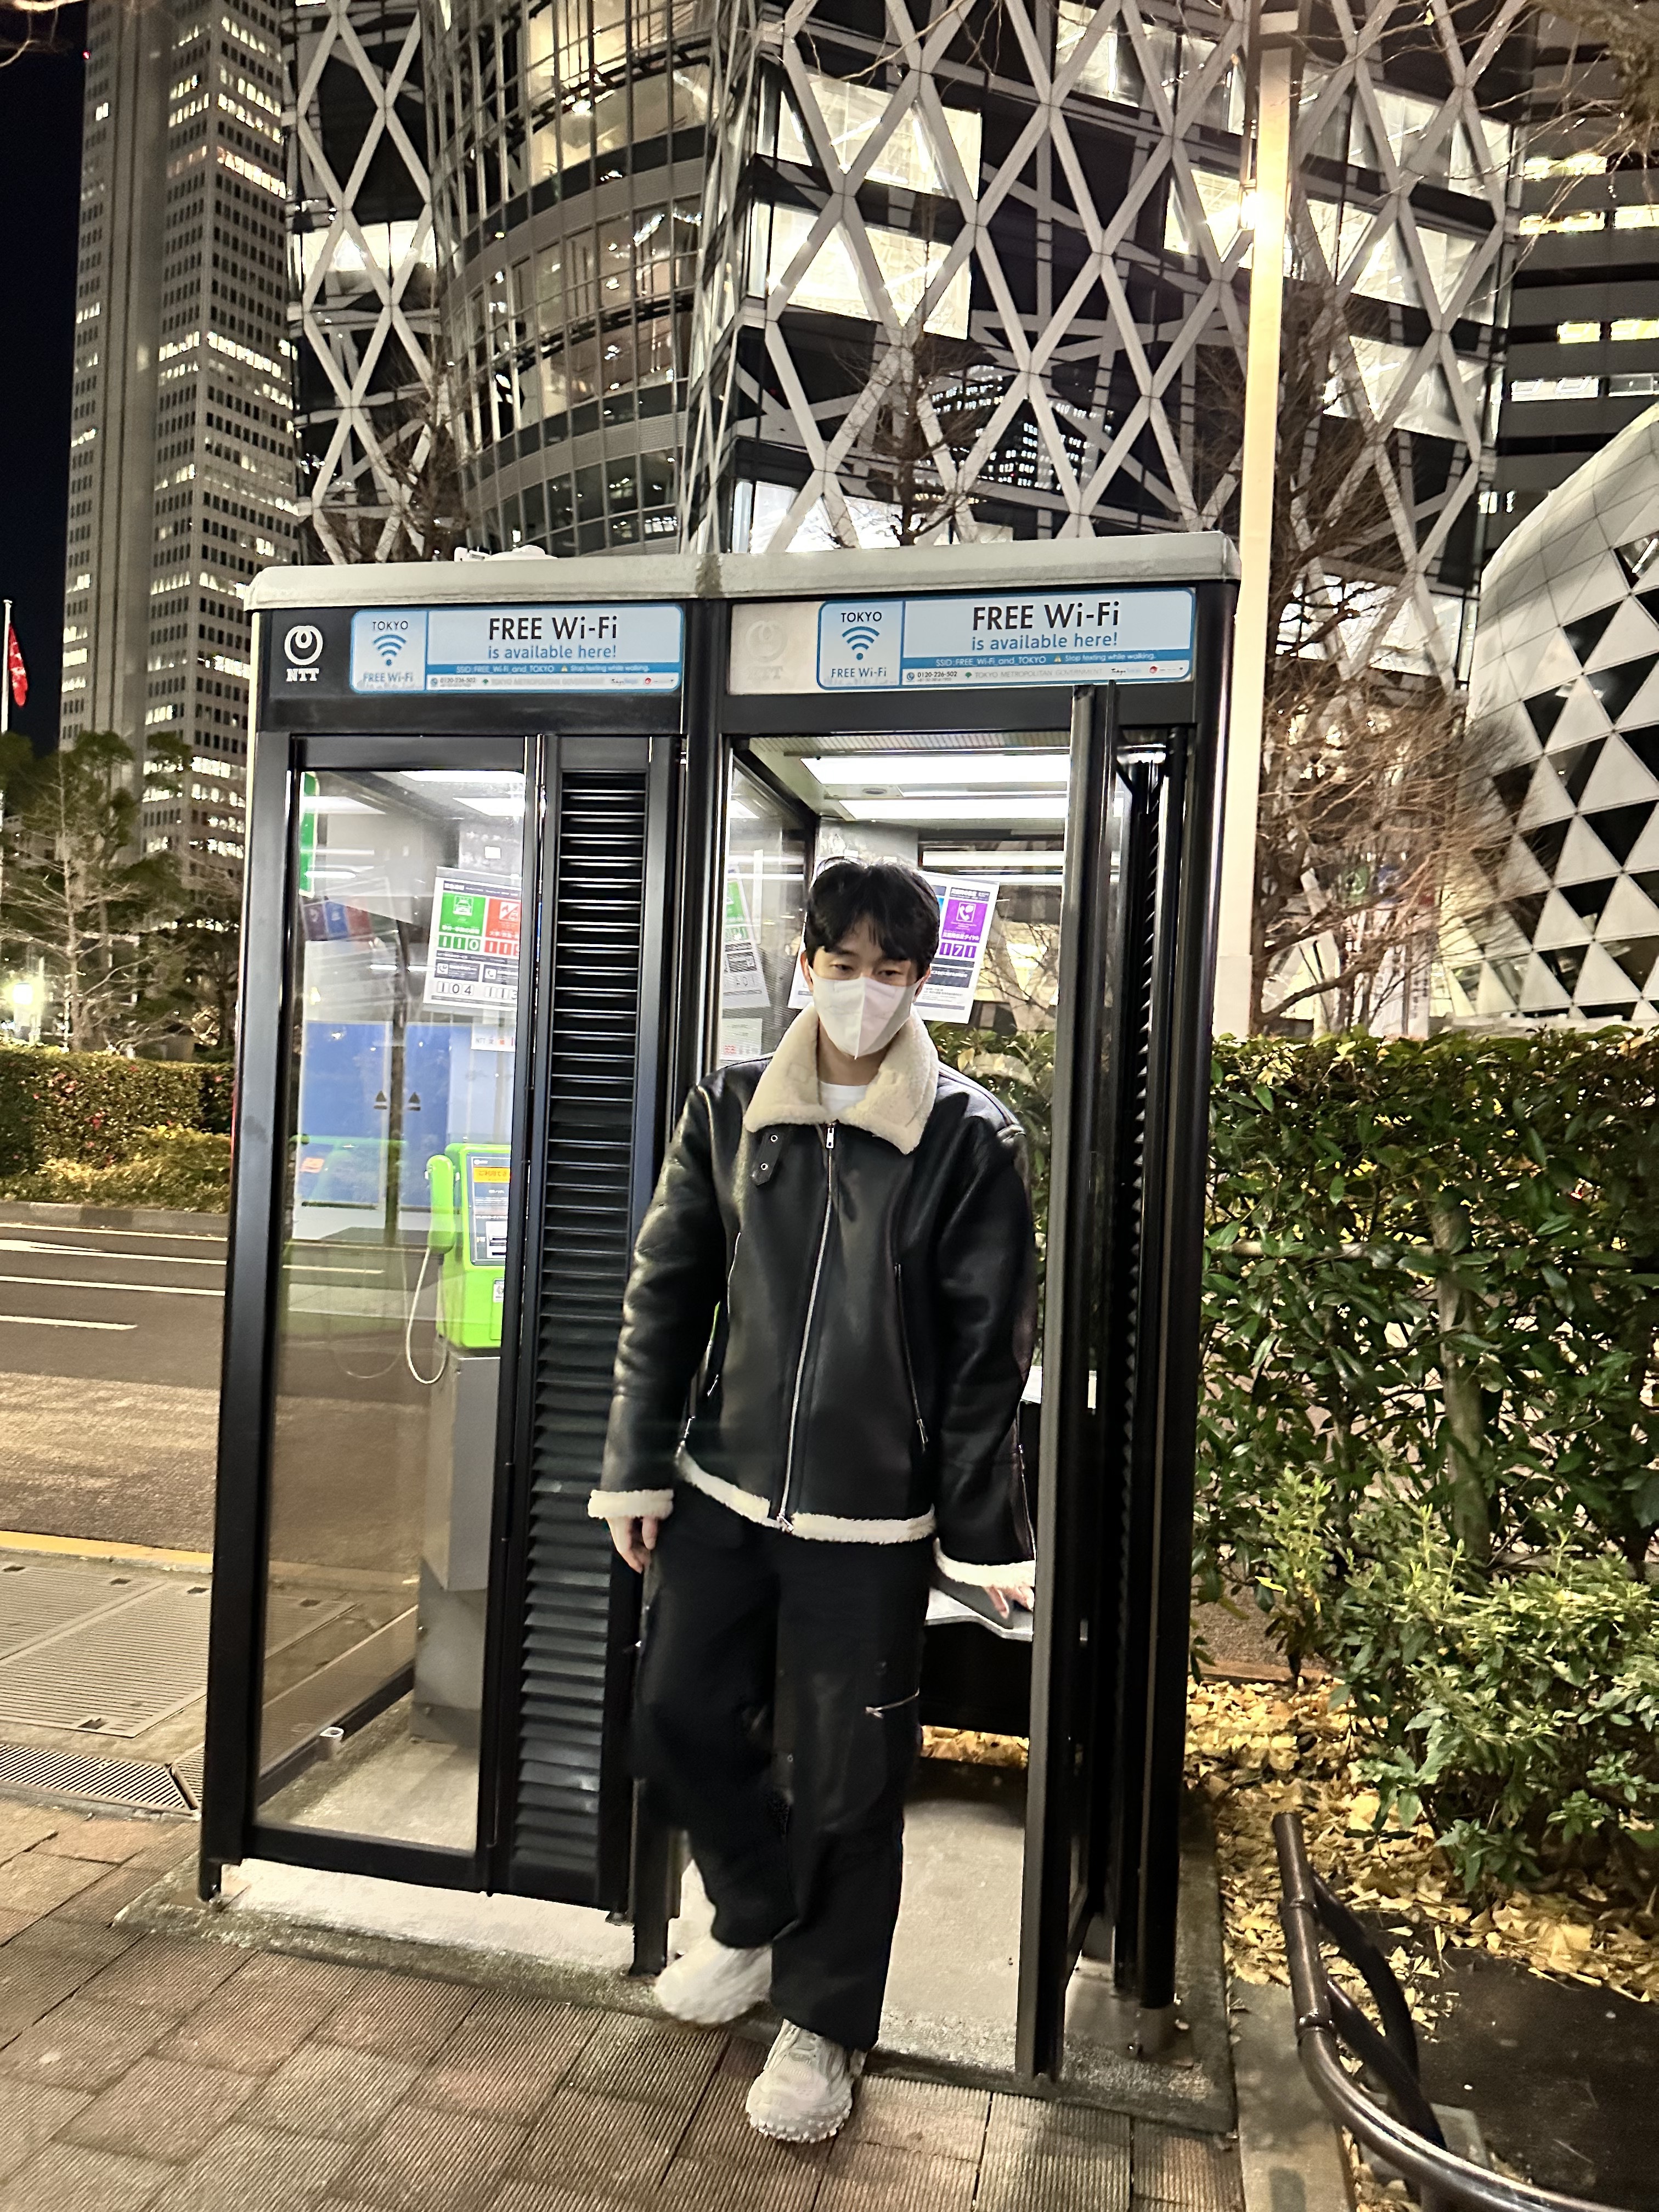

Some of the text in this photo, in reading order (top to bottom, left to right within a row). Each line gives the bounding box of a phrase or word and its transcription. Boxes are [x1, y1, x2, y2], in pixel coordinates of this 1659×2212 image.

[841, 611, 882, 622] TOKYO
[973, 601, 1119, 630] FREE Wi-Fi
[373, 620, 409, 630] TOKYO
[489, 616, 617, 640] FREE Wi-Fi
[972, 631, 1118, 651] is available here!
[488, 644, 616, 658] is available here!
[286, 668, 319, 681] NTT
[363, 672, 414, 682] FREE Wi-Fi
[831, 667, 887, 678] FREE Wi-Fi
[1001, 669, 1052, 678] METROPOLITAN
[442, 936, 479, 951] 110
[943, 943, 973, 958] 171
[442, 983, 472, 995] 104
